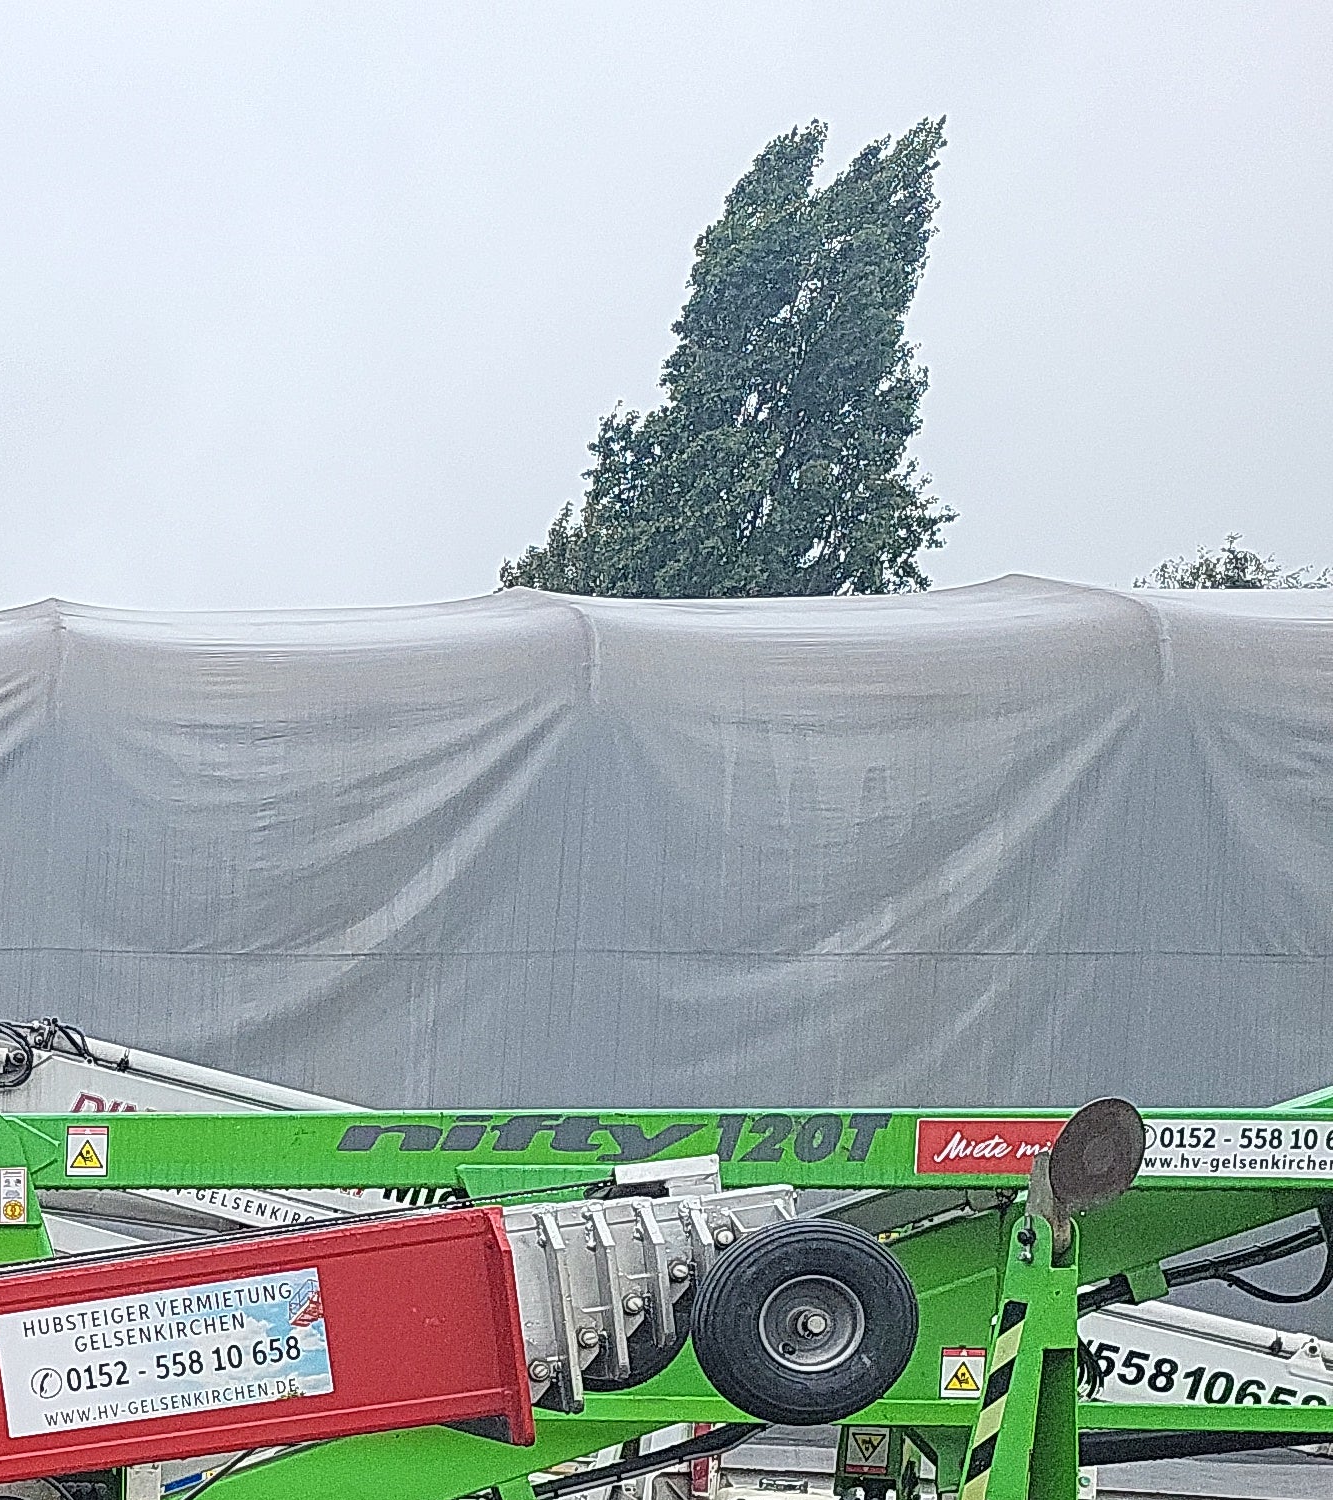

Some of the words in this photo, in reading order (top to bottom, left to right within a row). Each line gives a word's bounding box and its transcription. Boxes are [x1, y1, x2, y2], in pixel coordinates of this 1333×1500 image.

[336, 1114, 707, 1162] nifty
[717, 1113, 893, 1162] 120T
[934, 1131, 1012, 1162] Miete
[1159, 1126, 1216, 1149] 0152
[1238, 1127, 1282, 1150] 558
[1290, 1128, 1319, 1150] 10
[22, 1302, 149, 1338] HUBSTEIGER
[154, 1282, 293, 1318] VERMIETUNG
[74, 1312, 246, 1353] GELSENKIRCHEN
[66, 1360, 130, 1392] 0152
[155, 1349, 204, 1380] 558
[211, 1344, 243, 1372] 10
[252, 1335, 302, 1366] 658
[44, 1378, 297, 1427] WWW.HV-GELSENKIRCHEN.DE
